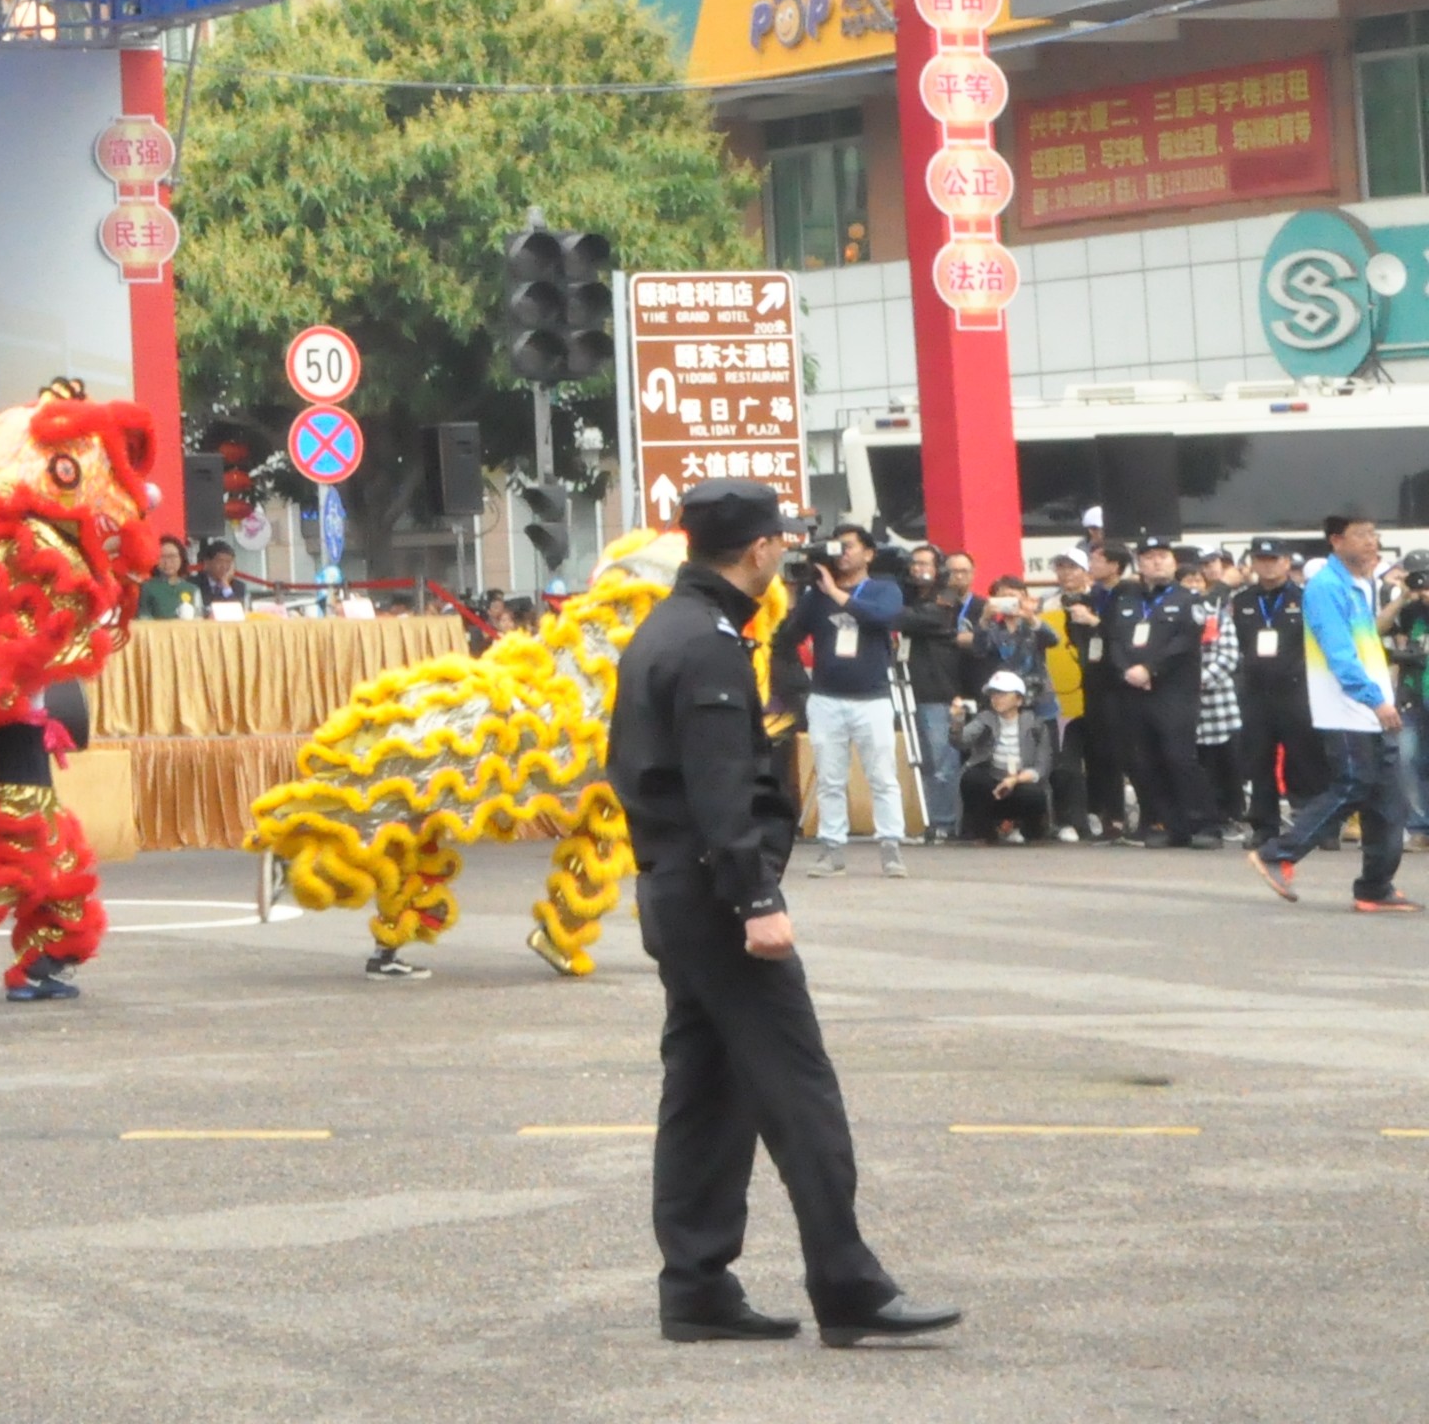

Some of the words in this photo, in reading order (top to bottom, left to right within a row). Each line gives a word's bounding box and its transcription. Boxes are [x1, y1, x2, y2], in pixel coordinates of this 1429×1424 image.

[936, 73, 993, 105] 平等
[109, 138, 161, 166] 富强
[942, 168, 999, 198] 公正
[114, 221, 165, 248] 民主
[949, 261, 1004, 293] 法治
[641, 310, 668, 323] YIHE
[675, 310, 711, 323] GRAND
[717, 310, 750, 323] HOTEL
[305, 347, 344, 384] 50
[677, 371, 717, 384] YIDONG
[724, 370, 791, 384] RESTAURANT
[678, 396, 794, 424] 假日广场
[688, 424, 738, 437] HOLIDAY
[745, 423, 782, 436] PLAZA
[681, 451, 797, 478] 大信新都汇
